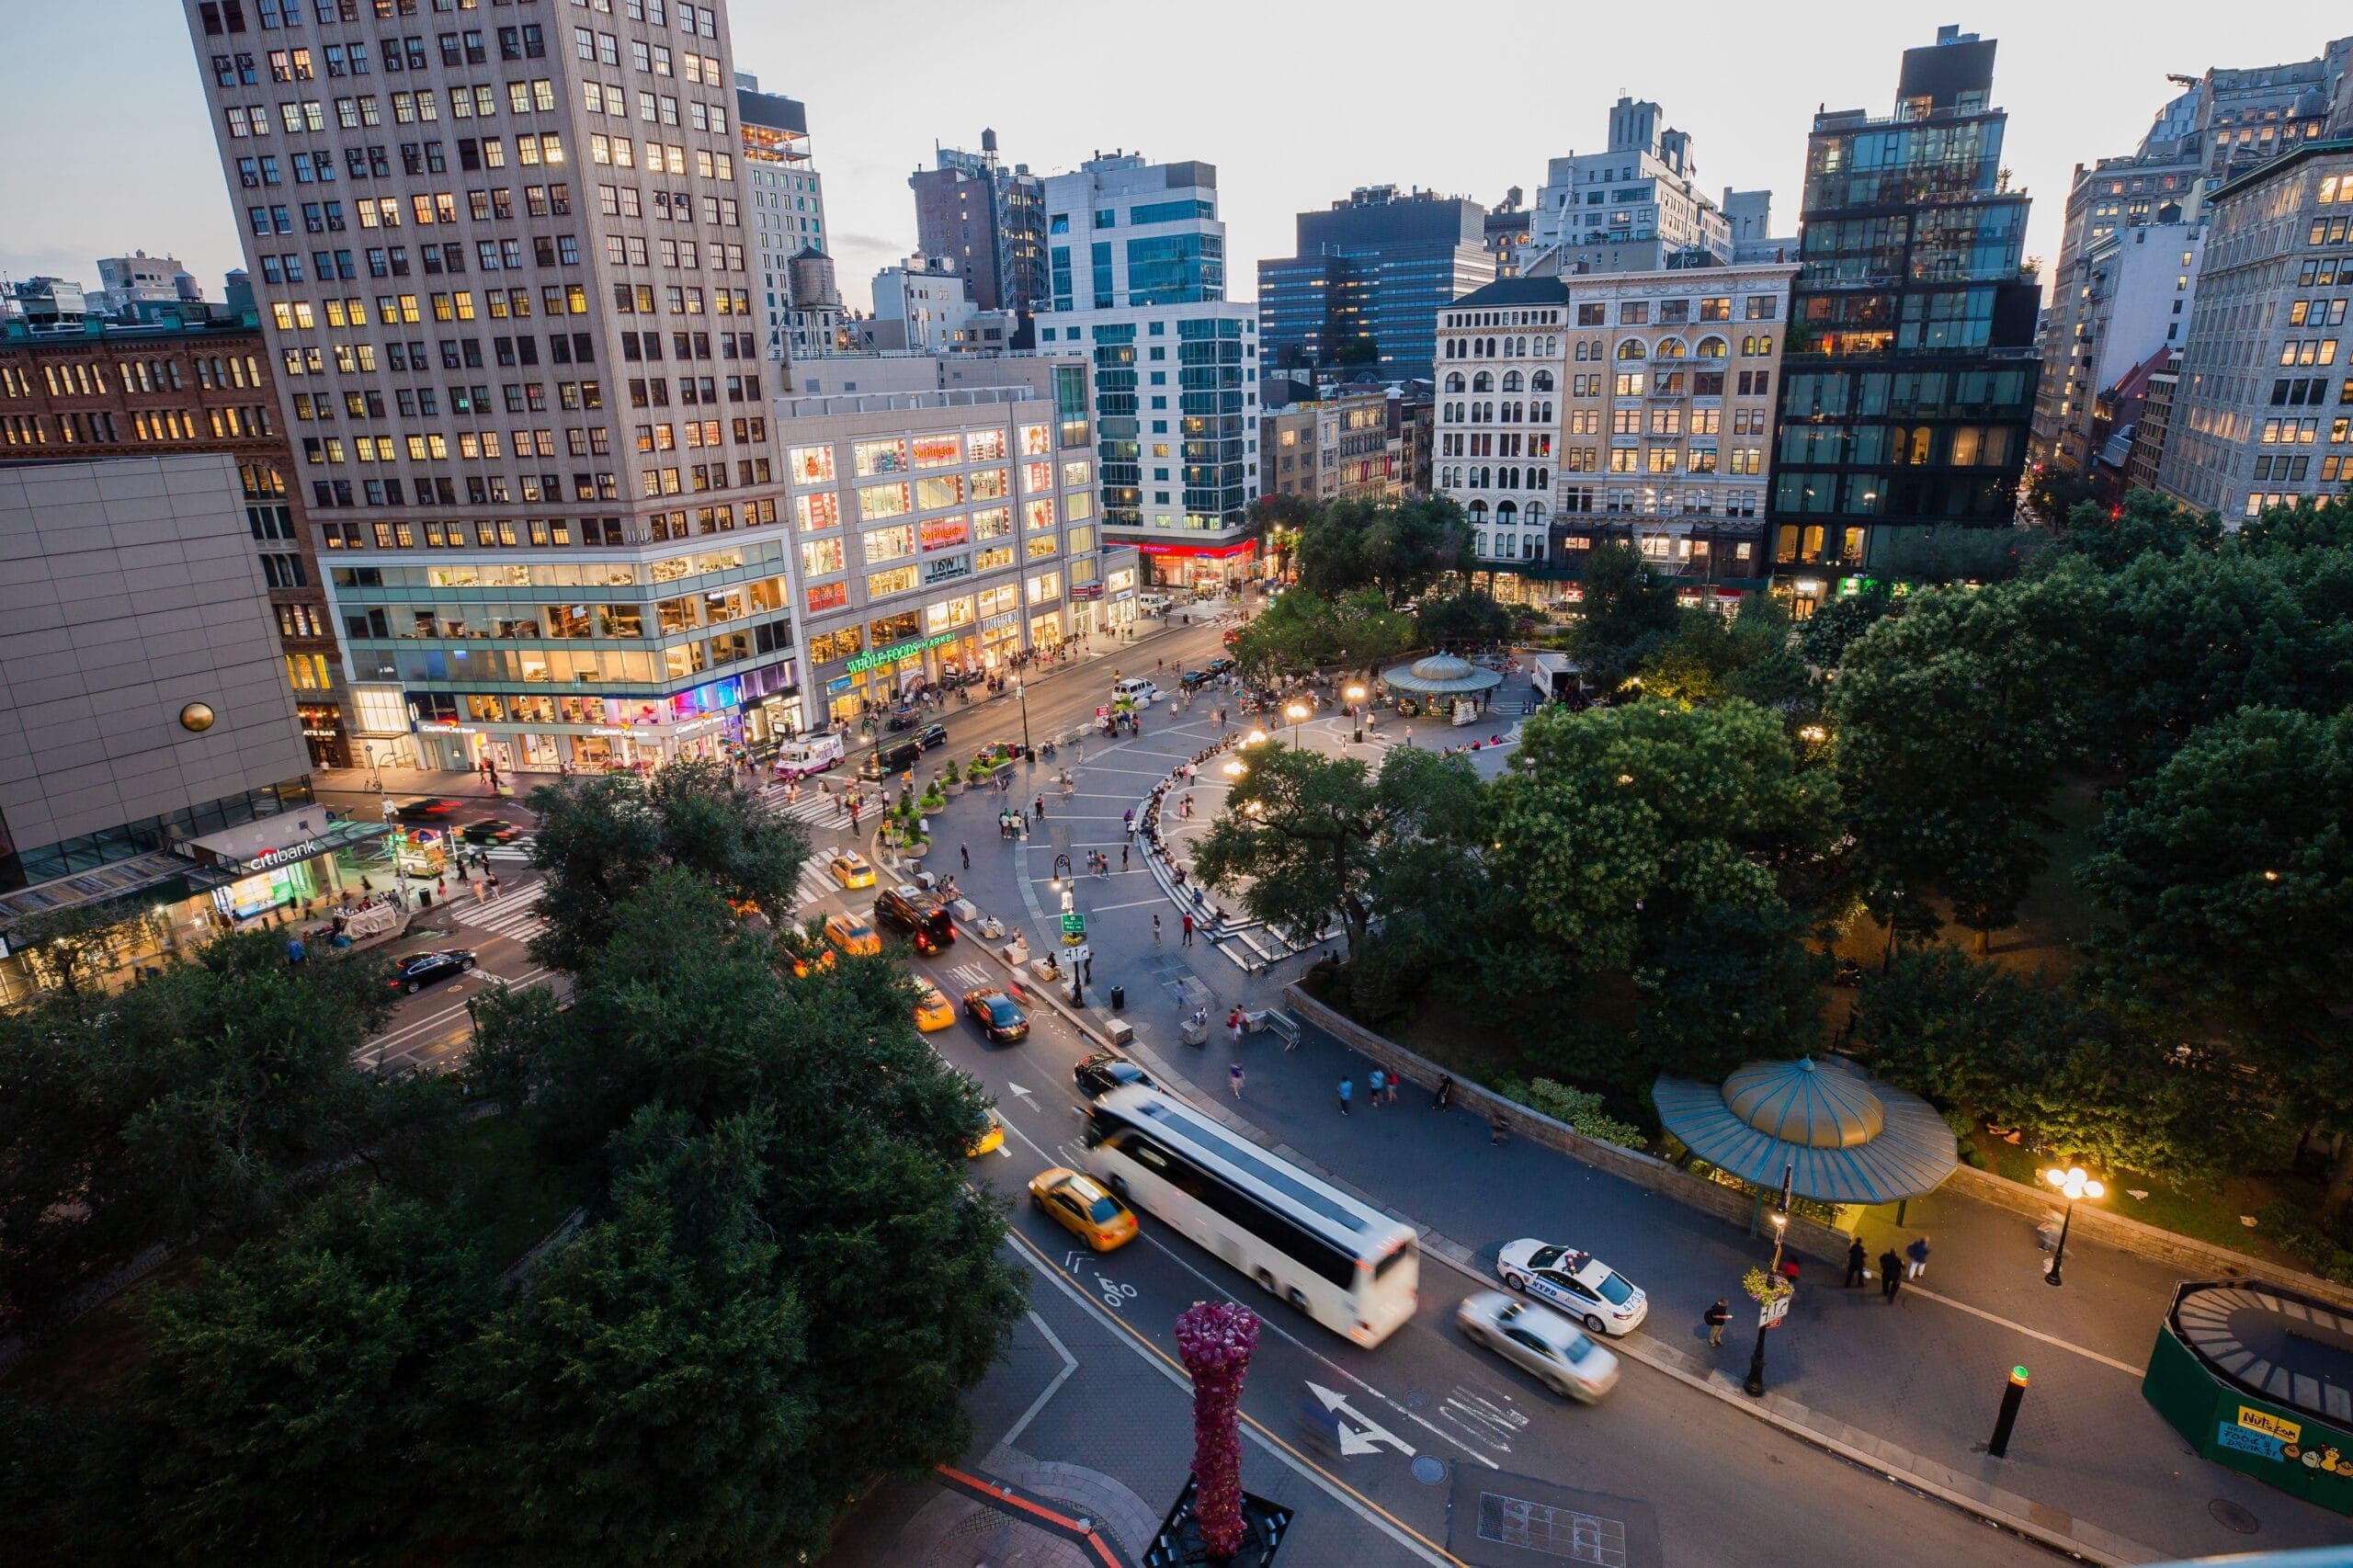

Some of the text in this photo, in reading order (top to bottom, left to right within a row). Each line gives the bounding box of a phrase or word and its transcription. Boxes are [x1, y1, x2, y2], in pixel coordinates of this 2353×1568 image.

[921, 526, 961, 541] Burlington
[847, 632, 956, 675] WHOLE FOODS MARKET
[250, 840, 316, 870] citibank
[1531, 1279, 1557, 1297] NYPD
[1622, 1290, 1644, 1312] 4733
[2224, 1429, 2258, 1446] FOOD
